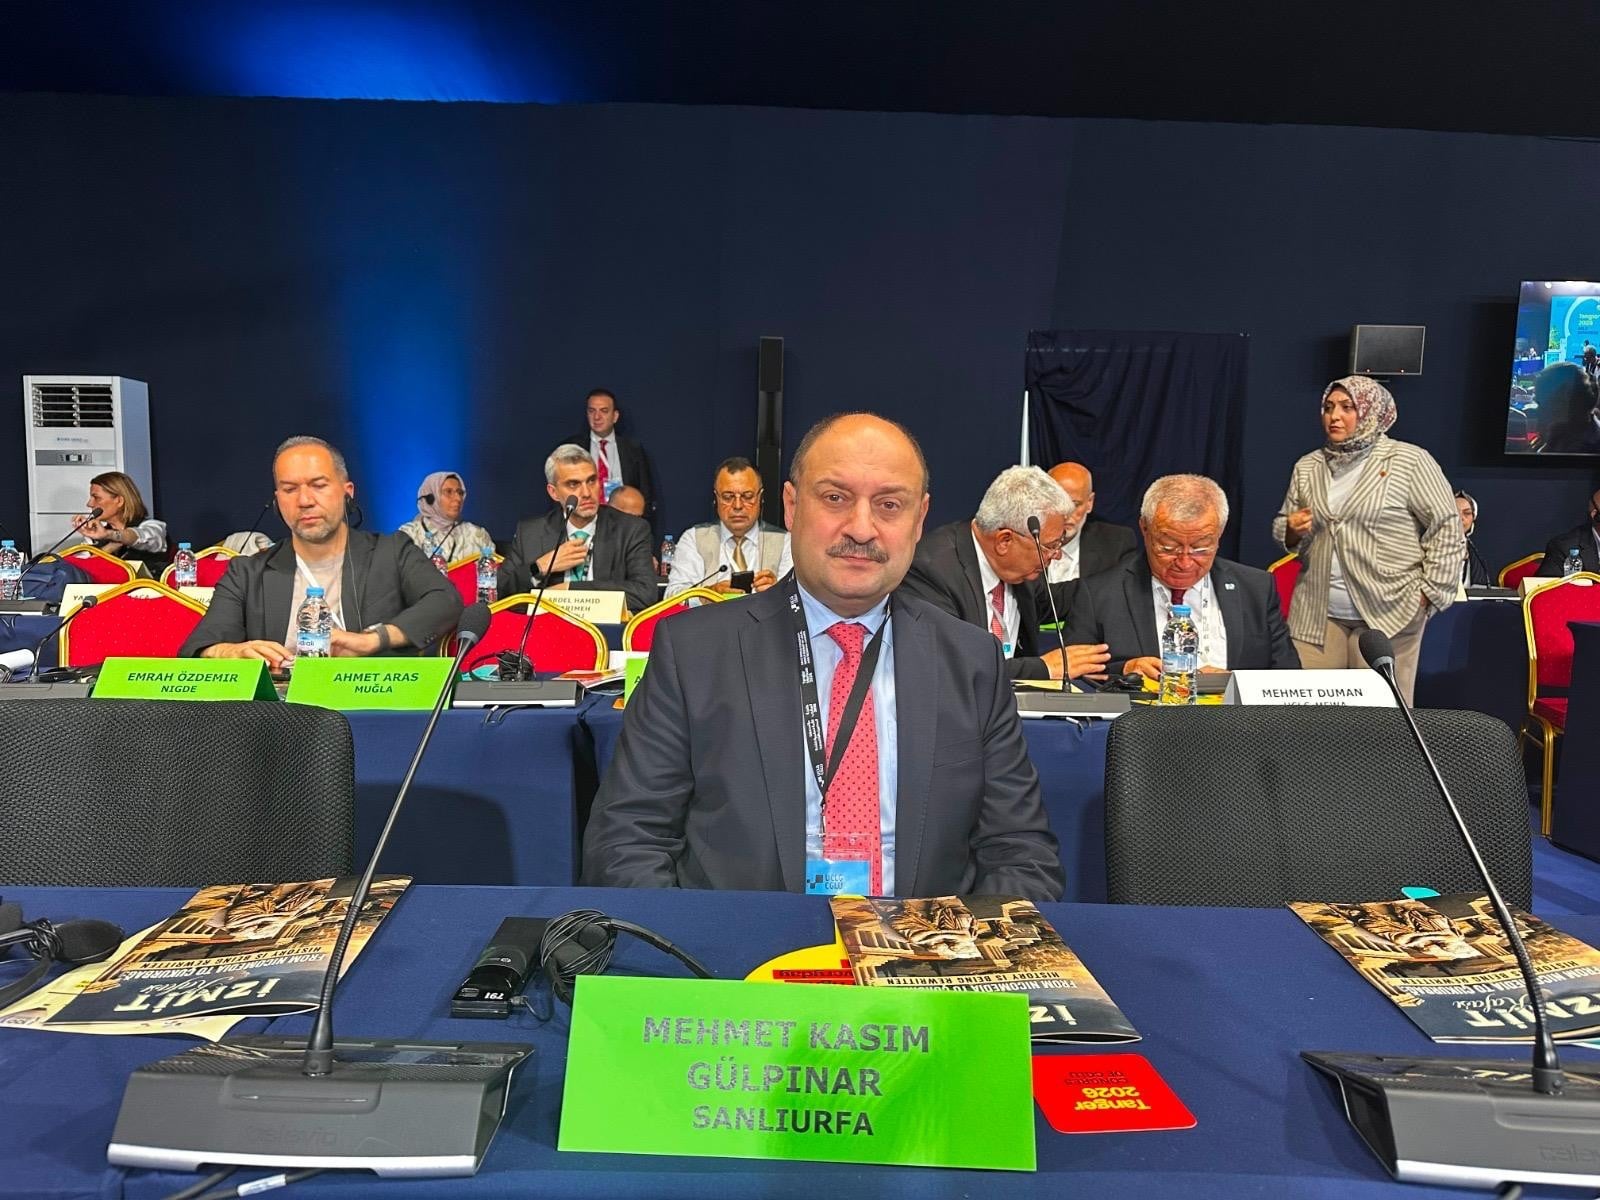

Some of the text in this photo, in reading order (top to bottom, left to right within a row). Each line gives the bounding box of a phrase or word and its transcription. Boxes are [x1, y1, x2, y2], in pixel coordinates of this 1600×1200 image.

[128, 670, 238, 682] EMRAH ÖZDEMIR
[334, 672, 419, 682] AHMET ARAS
[161, 685, 198, 693] NIGDE
[354, 684, 392, 693] MUĞLA
[1262, 688, 1364, 698] MEHMET DUMAN
[142, 946, 322, 970] HISTORY IS BEING REWRITTEN
[288, 954, 324, 965] FROM
[216, 956, 288, 973] NICOMEDIA
[197, 966, 214, 976] TO
[886, 977, 952, 986] REWRITTEN
[956, 976, 991, 984] BEING
[1400, 976, 1466, 986] REWRITTEN
[1474, 972, 1508, 982] BEING
[972, 980, 1038, 992] NICOMEDIA
[1042, 979, 1076, 990] FROM
[1474, 983, 1492, 994] TO
[484, 992, 504, 1000] 791
[643, 1016, 930, 1053] MEHMET KASIM
[687, 1056, 883, 1096] GÜLPINAR
[1082, 1086, 1140, 1098] 2026
[1074, 1098, 1152, 1110] Tanger
[692, 1104, 874, 1136] SANLIURFA
